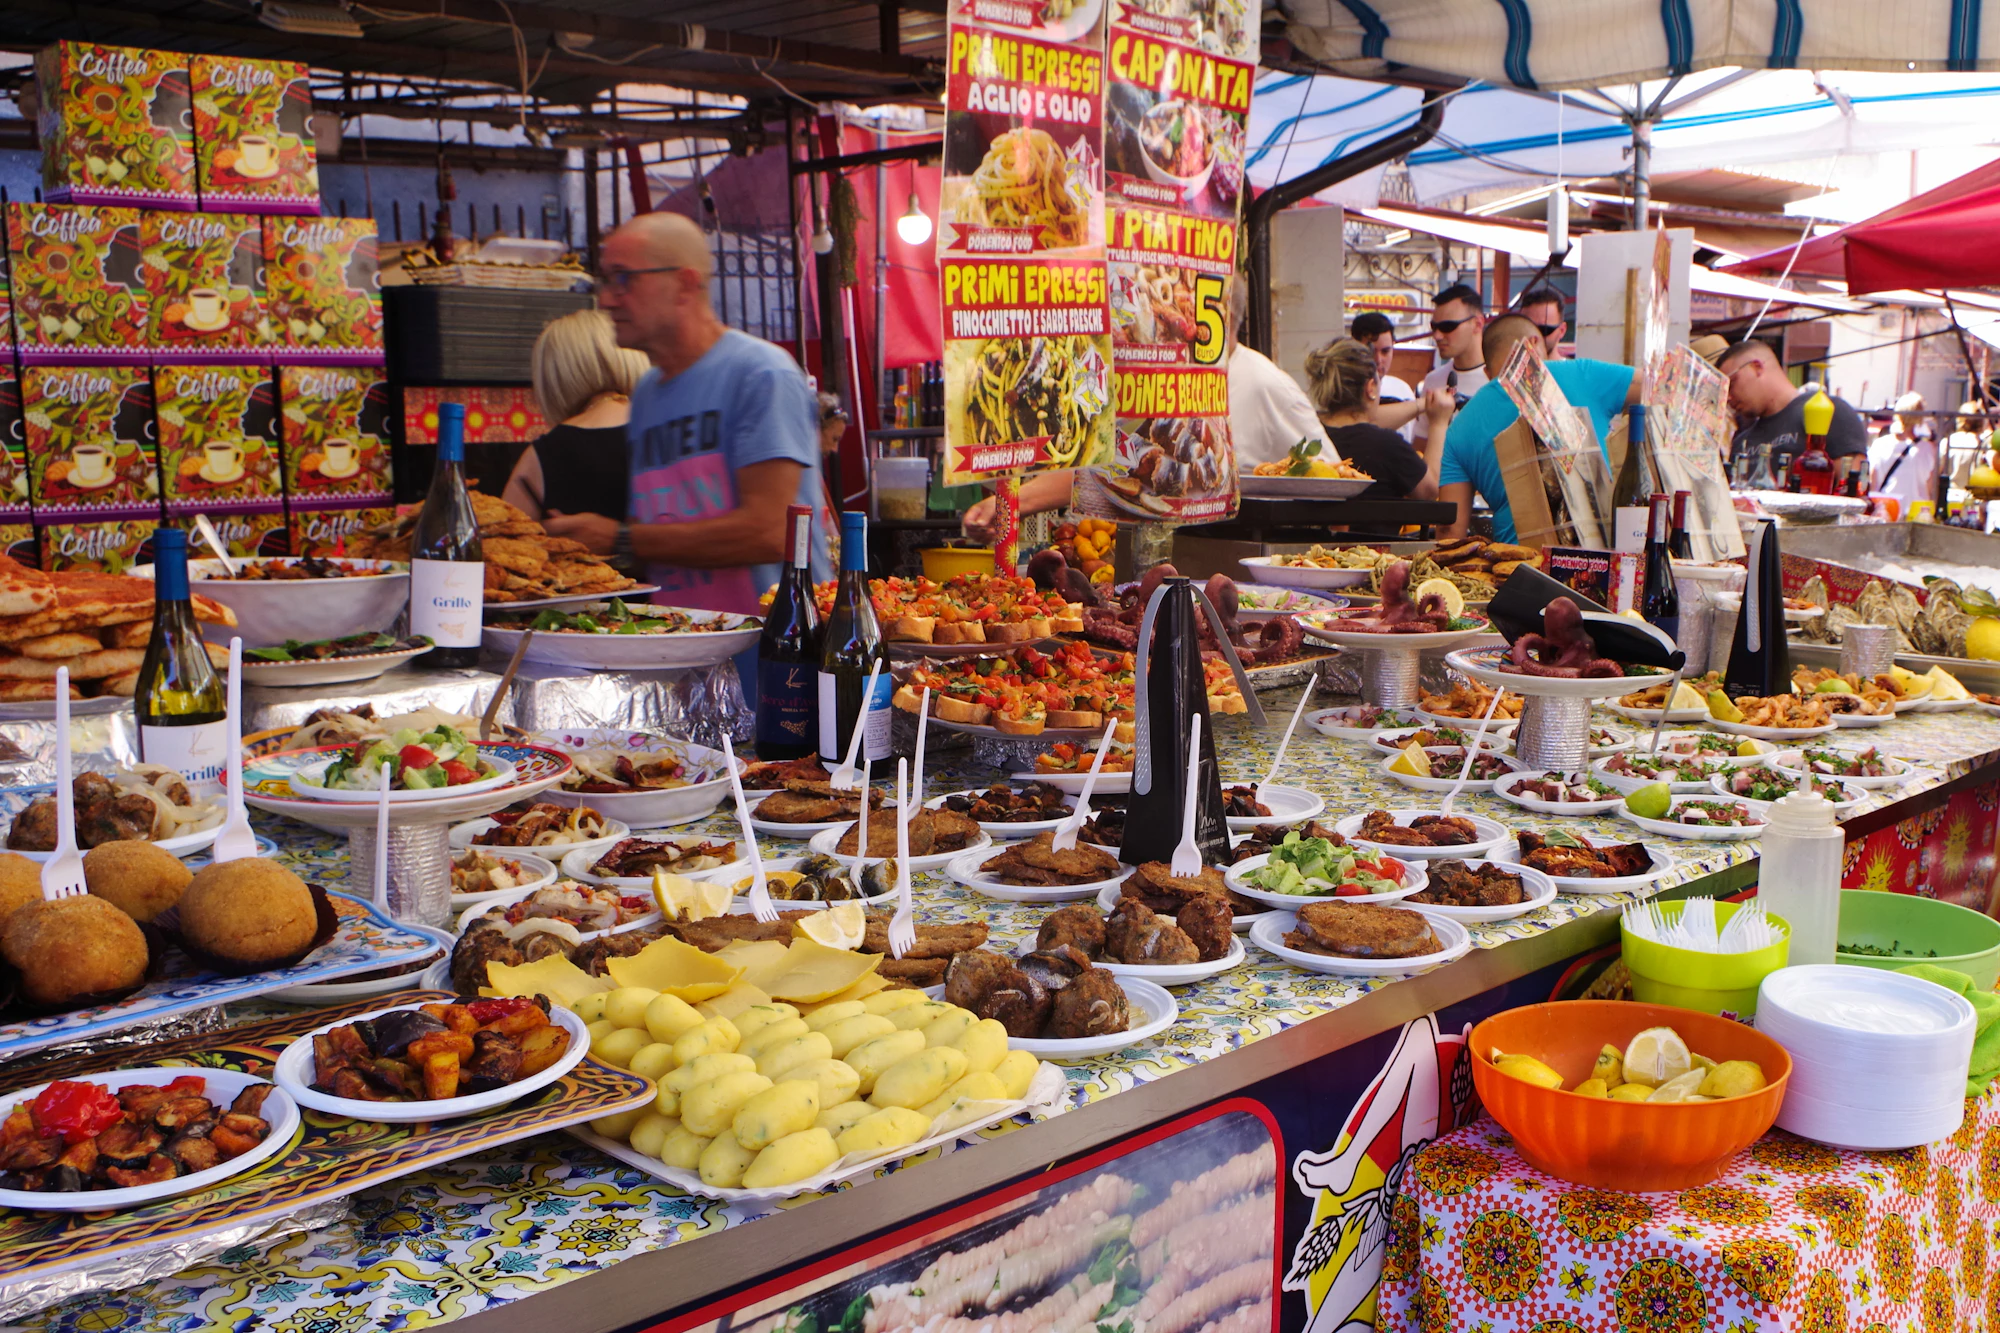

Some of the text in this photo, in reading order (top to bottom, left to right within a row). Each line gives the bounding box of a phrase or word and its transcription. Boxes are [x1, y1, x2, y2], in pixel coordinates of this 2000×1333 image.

[79, 52, 148, 83] Coffea
[210, 64, 275, 93] Coffea
[1111, 35, 1248, 109] CAPONATA
[967, 81, 1092, 124] AGLIO E OLIO
[31, 212, 102, 242] Coffea
[161, 217, 226, 248] Coffea
[283, 223, 345, 250] Coffea
[967, 234, 1033, 251] DOMENICO FOOD
[952, 307, 1104, 337] FINOCCHIETTO E SARDE FRESCHE
[1195, 274, 1225, 364] 5
[43, 372, 112, 404] Coffea
[176, 372, 240, 401] Coffea
[300, 372, 357, 400] Coffea
[972, 448, 1035, 470] DOMENICO FOOD
[60, 528, 127, 559] Coffea
[1552, 554, 1588, 570] DOMENICO
[1588, 557, 1608, 573] FOOD
[432, 595, 471, 608] Grillo
